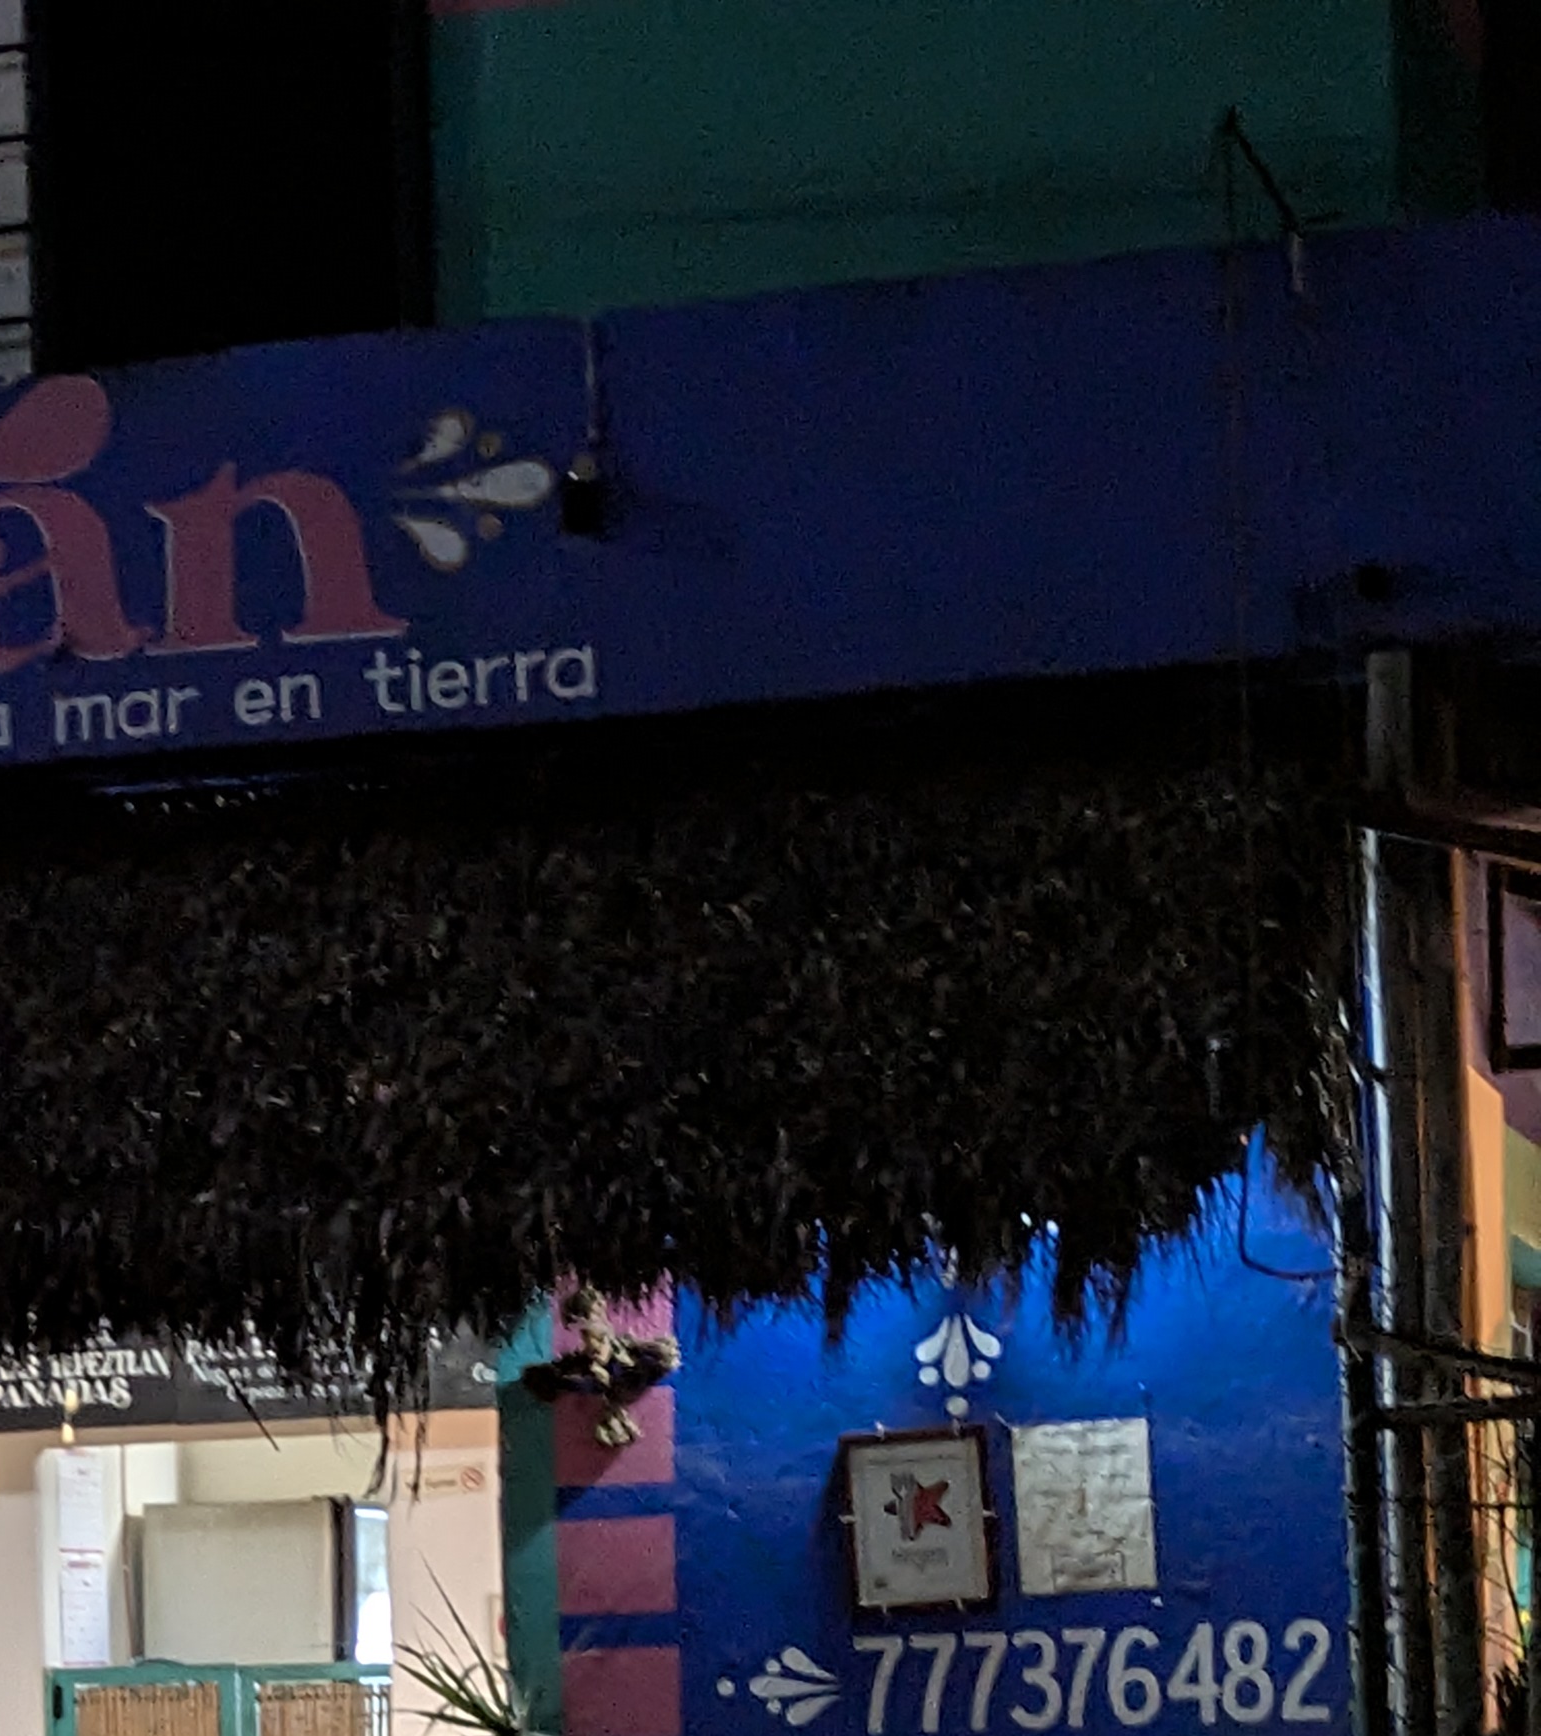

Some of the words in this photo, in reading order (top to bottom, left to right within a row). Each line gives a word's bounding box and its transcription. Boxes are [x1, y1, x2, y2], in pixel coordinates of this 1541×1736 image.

[52, 682, 199, 746] mar
[233, 669, 323, 726] en
[362, 645, 597, 717] tierra
